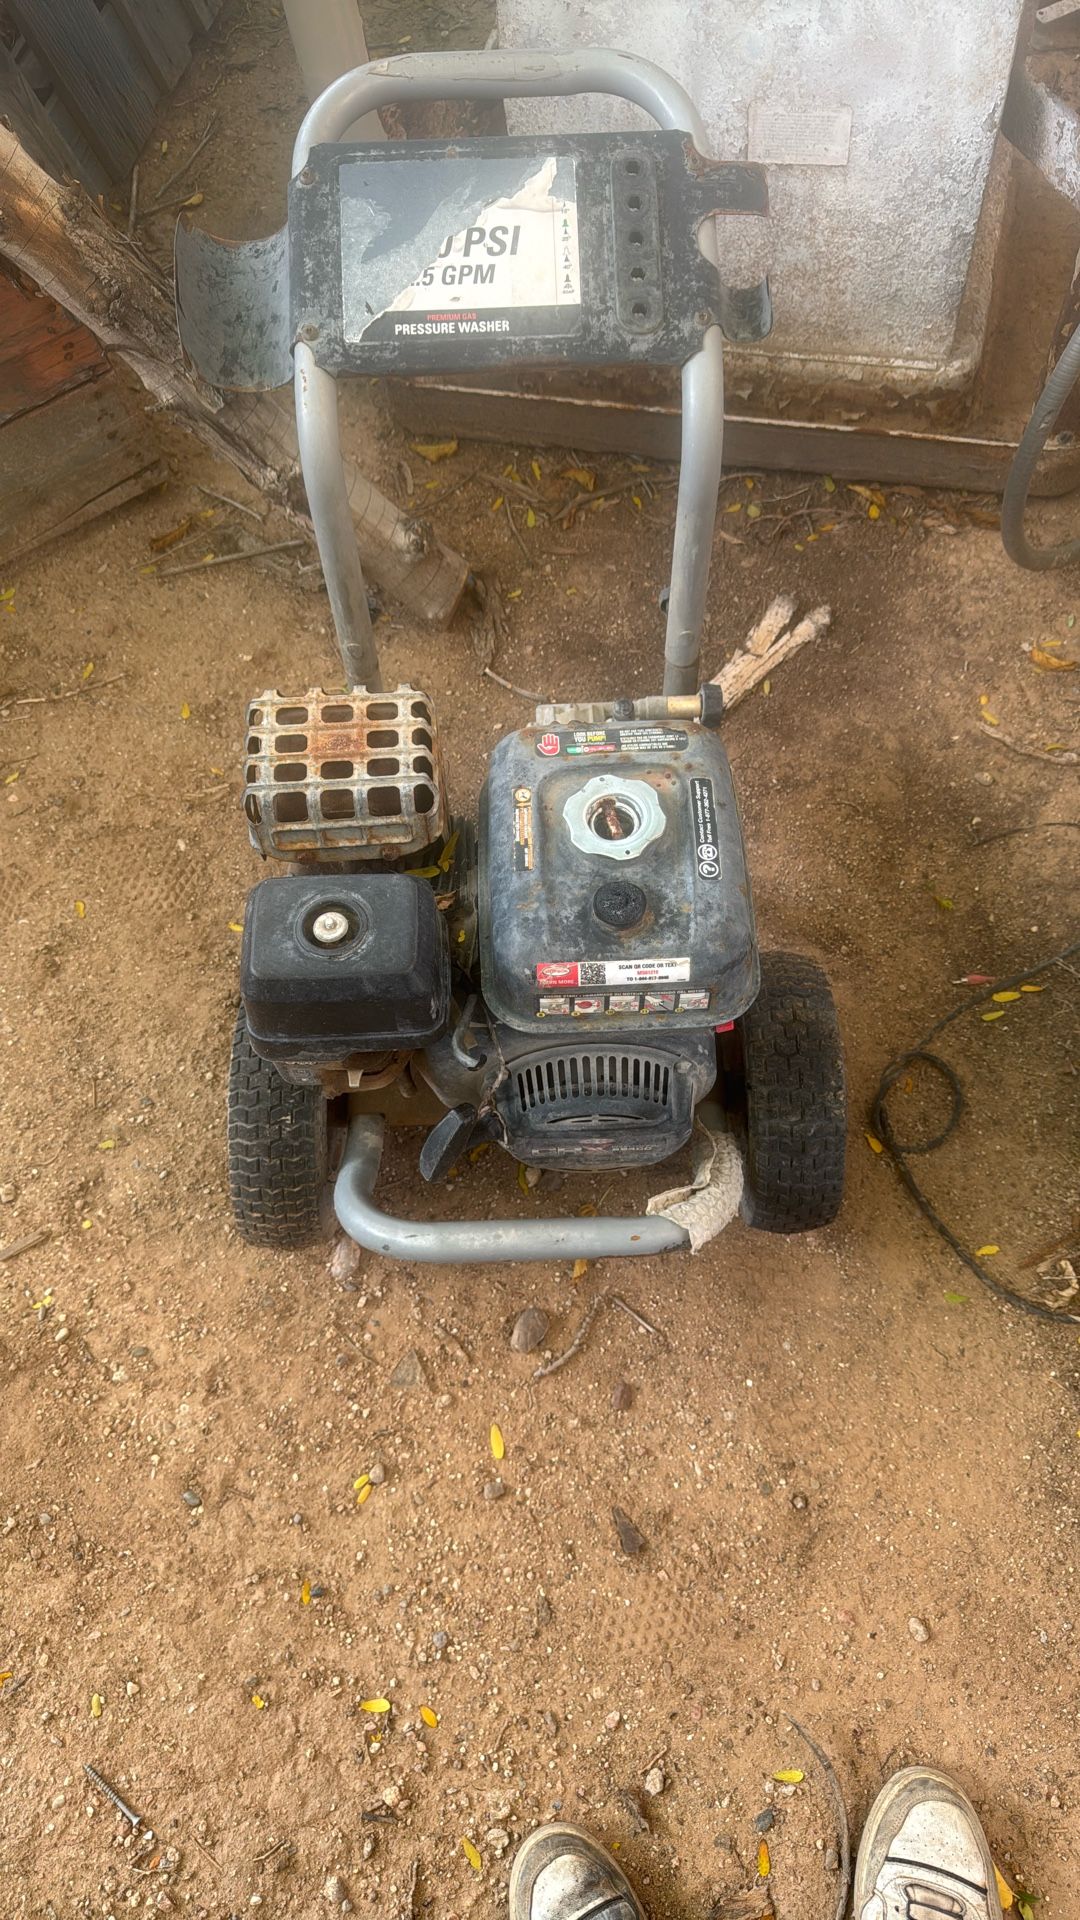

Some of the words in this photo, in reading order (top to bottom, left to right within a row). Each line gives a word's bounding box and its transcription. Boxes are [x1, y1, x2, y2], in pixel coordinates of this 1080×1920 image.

[463, 225, 521, 258] PSI
[441, 263, 496, 285] GPM
[427, 313, 460, 321] PREMIUM
[462, 312, 477, 320] GAS
[395, 322, 455, 335] PRESSURE
[458, 320, 510, 333] WASHER
